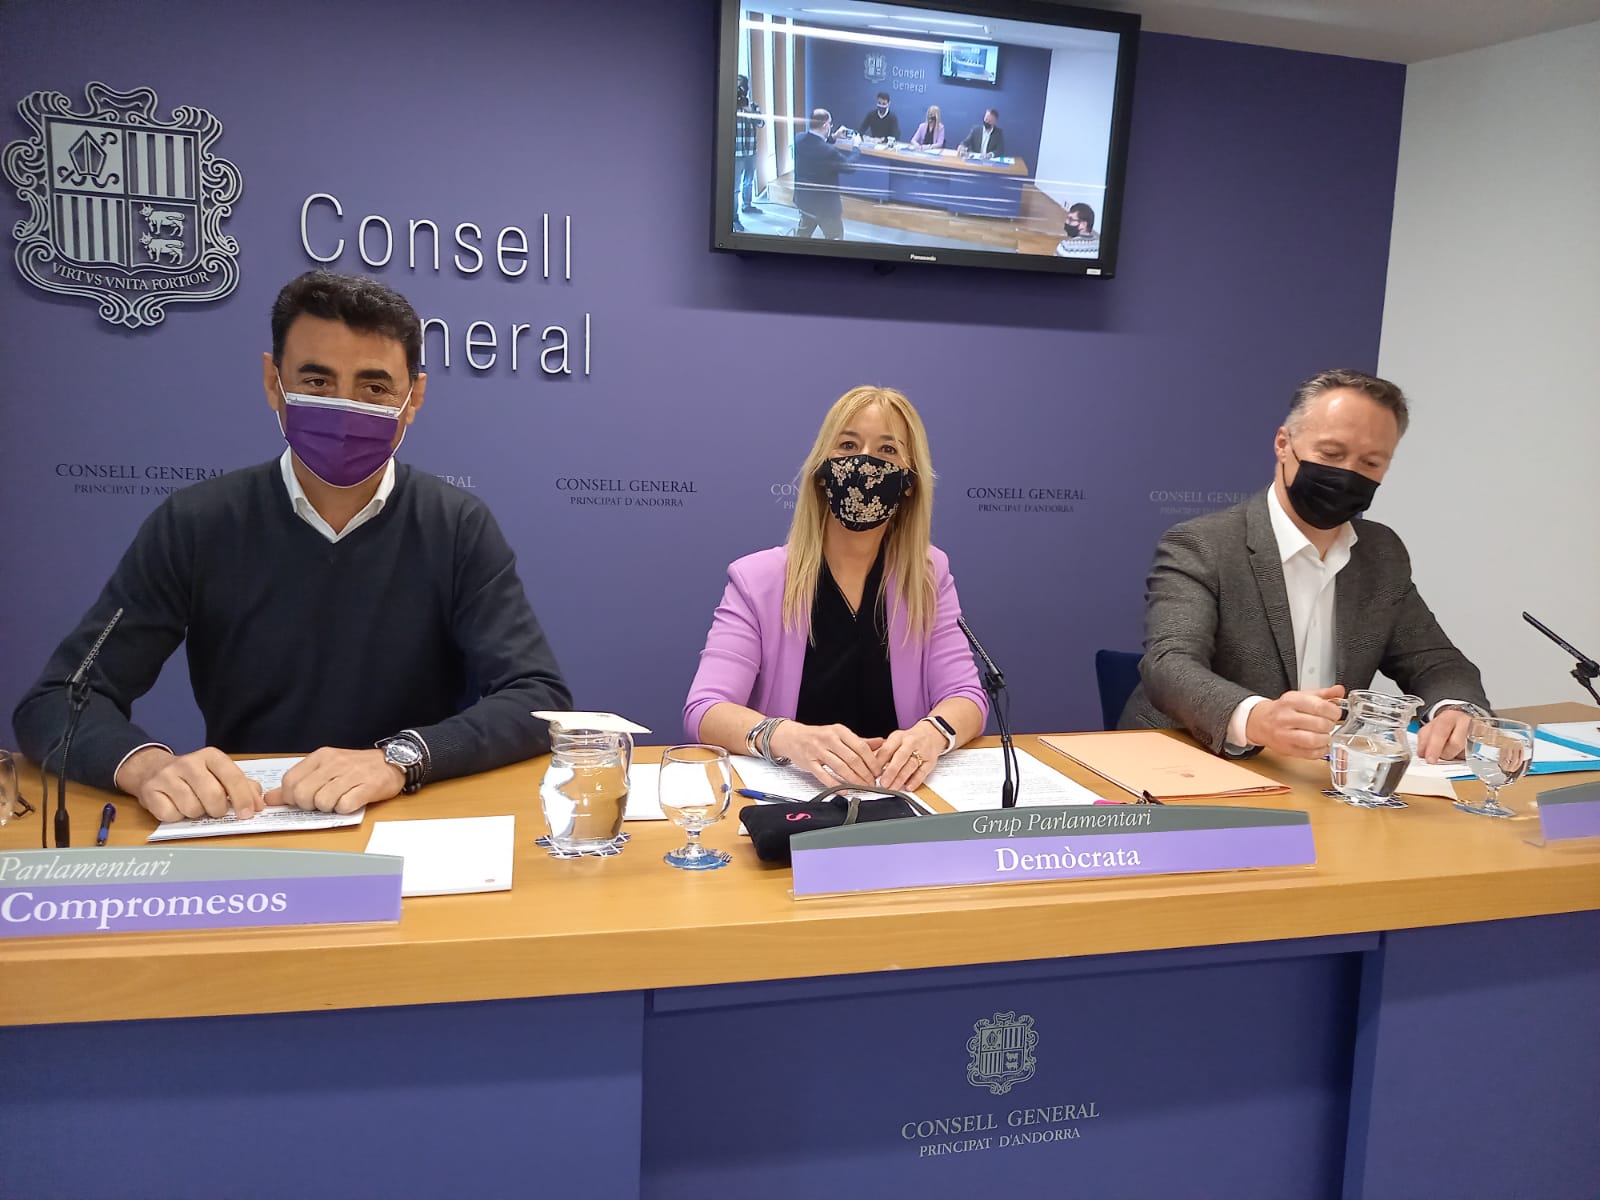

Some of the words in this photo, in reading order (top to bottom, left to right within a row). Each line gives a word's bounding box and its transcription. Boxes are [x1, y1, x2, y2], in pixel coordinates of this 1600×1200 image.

[892, 65, 925, 79] Consell
[892, 81, 927, 93] General
[300, 193, 571, 280] Consell
[52, 262, 102, 286] VIRTVS
[105, 276, 149, 290] VNITA
[152, 271, 210, 290] FORTIOR
[420, 313, 591, 375] neral
[55, 463, 141, 479] CONSELL
[74, 484, 137, 495] PRINCIPAT
[555, 477, 626, 492] CONSELL
[629, 480, 697, 493] GENERAL
[967, 487, 1025, 500] CONSELL
[1028, 488, 1088, 500] GENERAL
[570, 496, 622, 506] PRINCIPAT
[624, 497, 684, 507] D'ANDORRA
[1149, 490, 1205, 502] CONSELL
[978, 503, 1022, 513] PRINCIPAT
[972, 815, 1022, 838] Grup
[1027, 809, 1152, 832] Parlamentari
[0, 853, 174, 881] Parlamentari
[995, 846, 1141, 873] Demòcrata
[1, 890, 287, 930] Compromesos
[901, 1113, 998, 1140] CONSELL
[1007, 1102, 1100, 1127] GENERAL
[919, 1137, 993, 1158] PRINCIPAT
[999, 1127, 1081, 1148] D'ANDORRA
